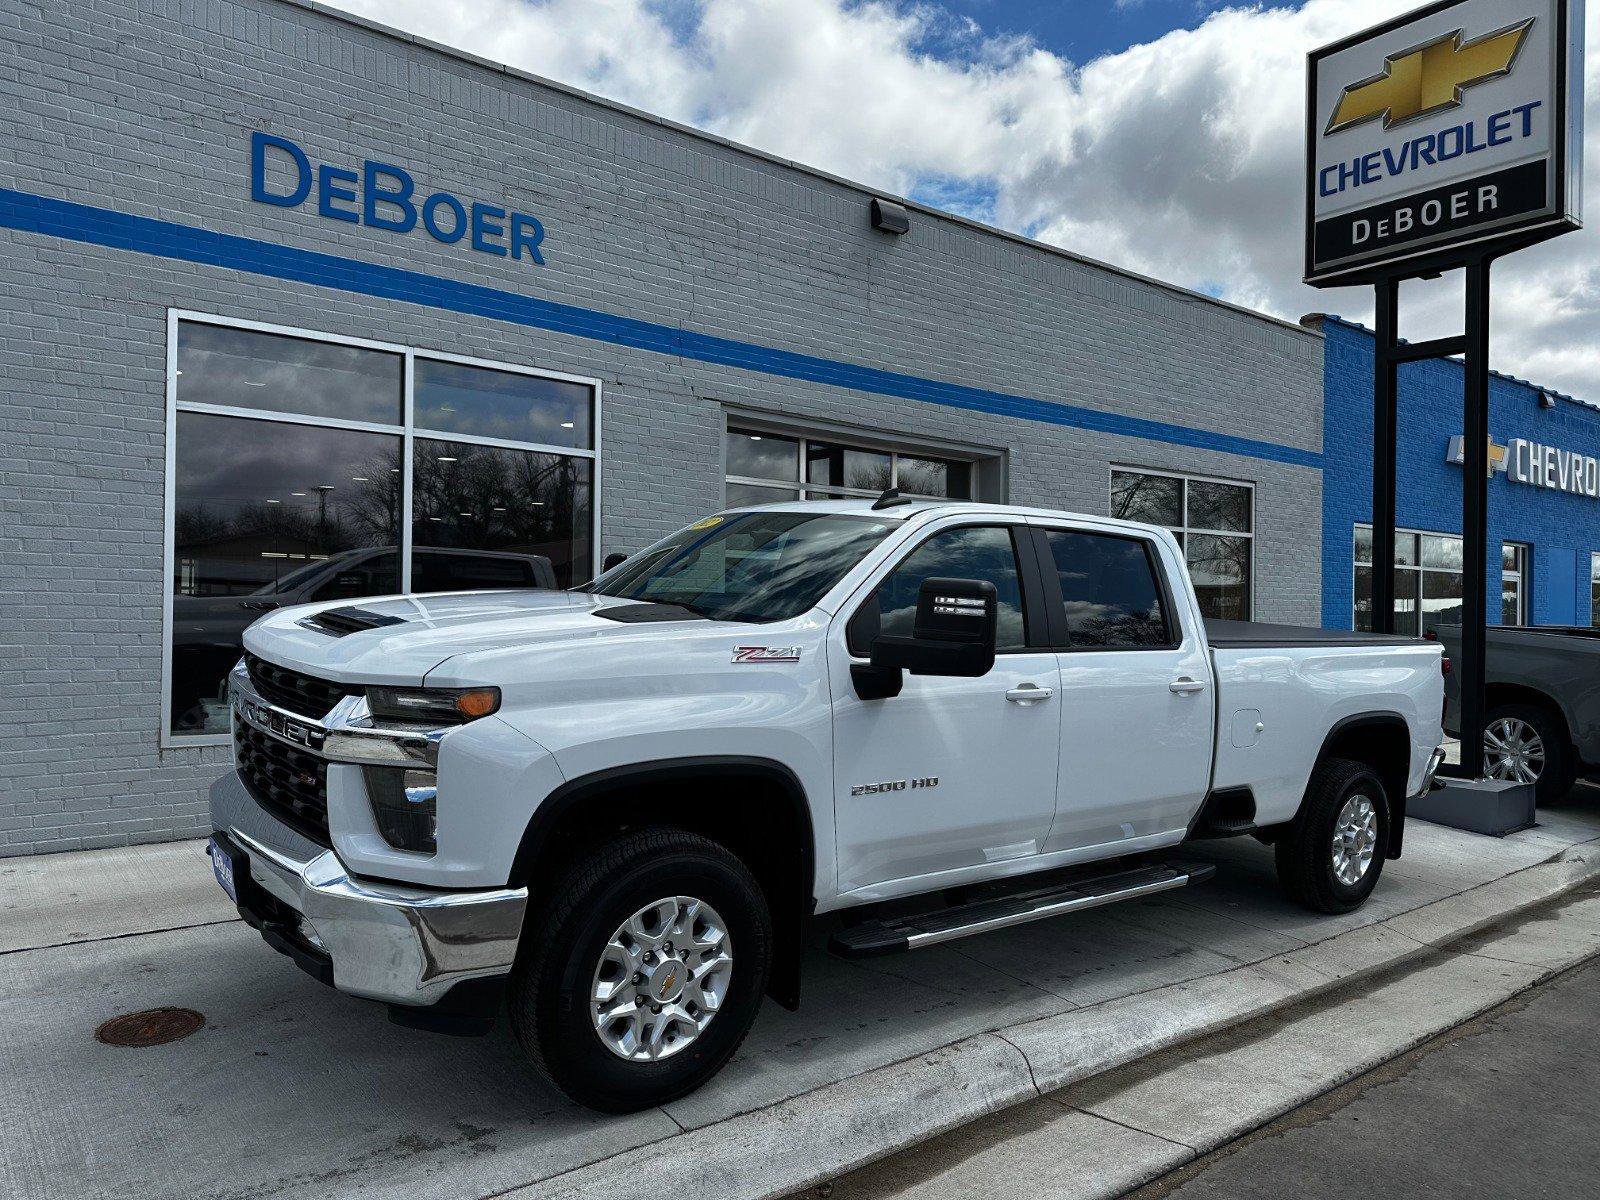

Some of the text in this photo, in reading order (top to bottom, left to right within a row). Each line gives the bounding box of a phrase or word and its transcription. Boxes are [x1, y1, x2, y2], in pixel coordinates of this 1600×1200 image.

[1319, 100, 1542, 198] CHEVROLET
[1509, 438, 1600, 498] CHEVRO
[731, 645, 802, 663] Z71
[851, 776, 939, 796] 2500 HD
